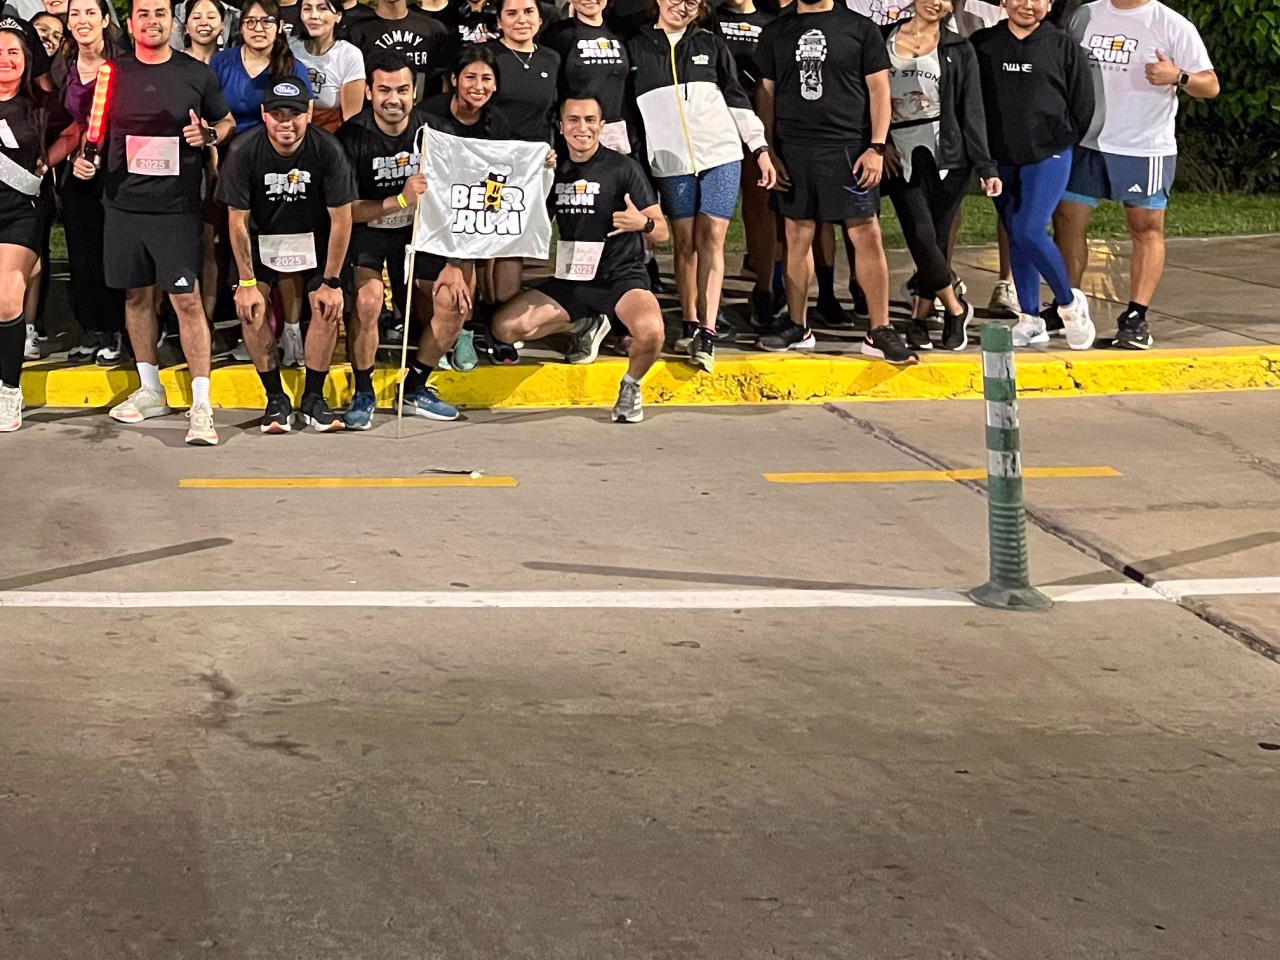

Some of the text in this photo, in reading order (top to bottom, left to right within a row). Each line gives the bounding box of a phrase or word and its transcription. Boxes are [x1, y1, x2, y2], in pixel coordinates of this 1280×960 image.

[375, 30, 423, 49] TOMMY
[1089, 34, 1138, 52] BEER
[580, 48, 621, 58] RUN
[1087, 47, 1131, 64] RUN
[140, 159, 166, 170] 2025
[374, 164, 419, 181] RUN
[264, 168, 311, 186] BEER
[555, 179, 601, 195] BEER
[555, 193, 595, 206] RUN
[451, 209, 522, 236] RUN
[275, 256, 302, 267] 2025
[570, 264, 593, 275] 2025
